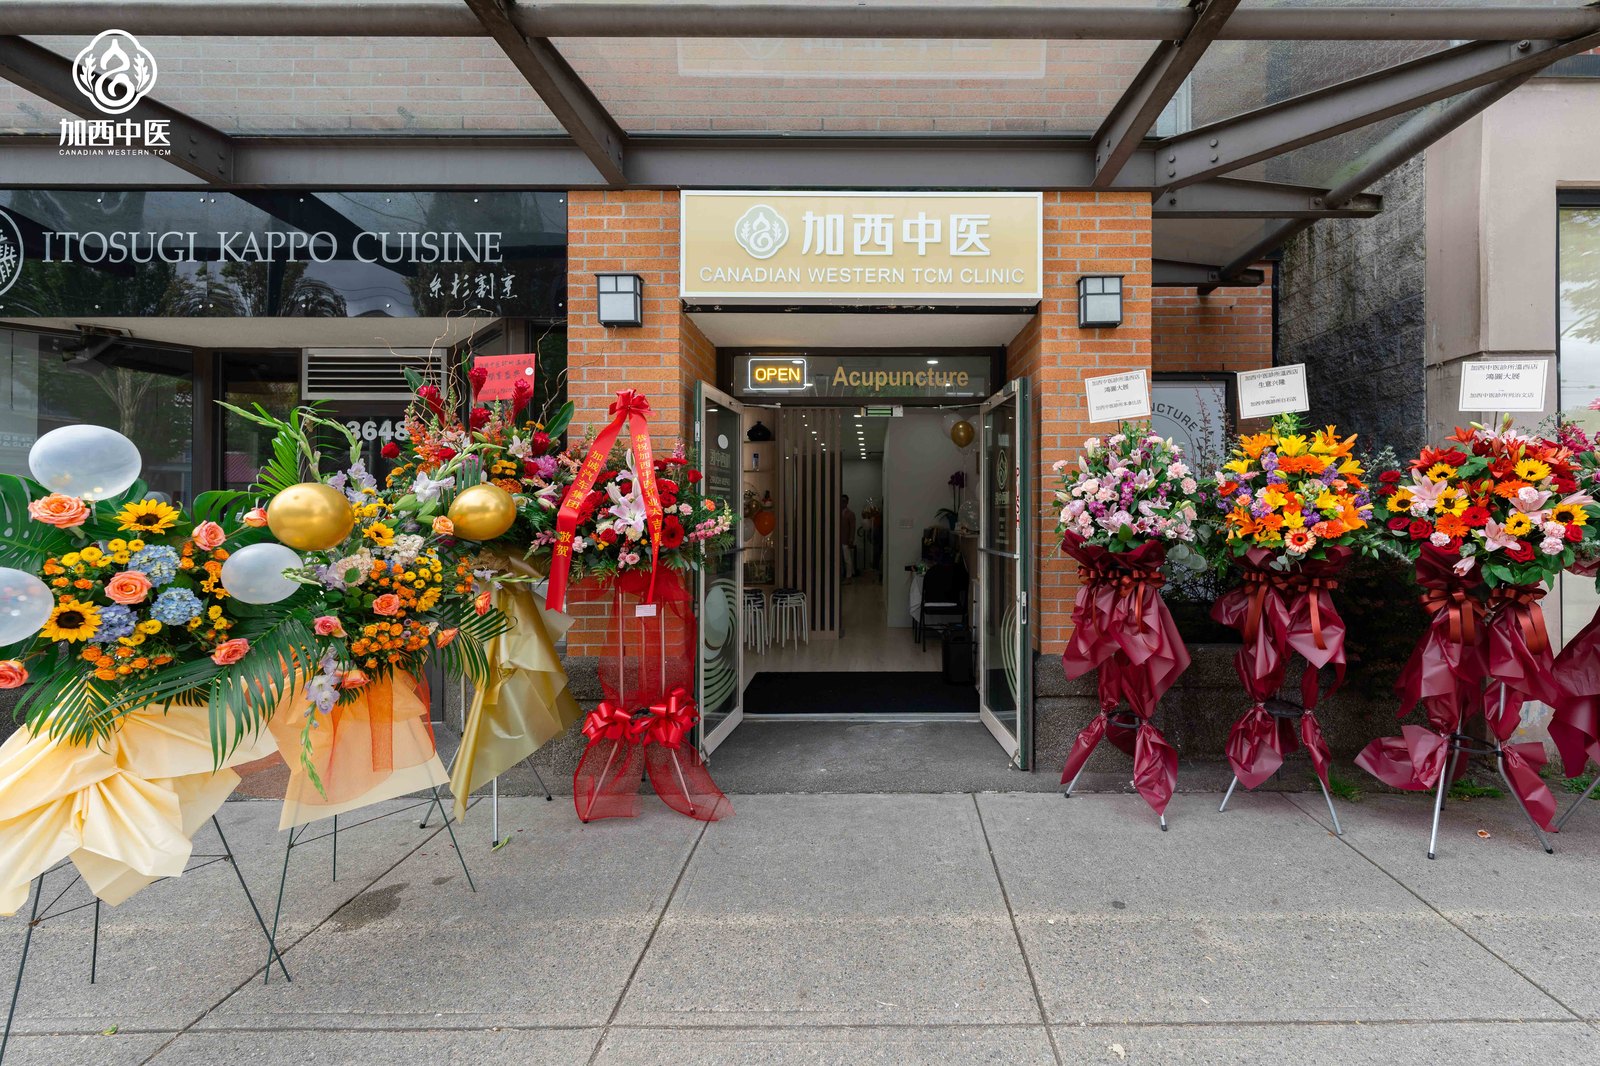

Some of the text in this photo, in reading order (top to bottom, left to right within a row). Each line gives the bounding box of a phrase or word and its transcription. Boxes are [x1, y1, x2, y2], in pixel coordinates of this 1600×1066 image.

[801, 211, 992, 256] 加西中医
[41, 231, 503, 263] ITOSUGI KAPPO CUISINE
[699, 266, 1025, 284] CANADIAN WESTERN TCM CLINIC
[754, 366, 801, 383] OPEN
[832, 366, 969, 391] Acupuncture
[346, 420, 410, 441] 3648
